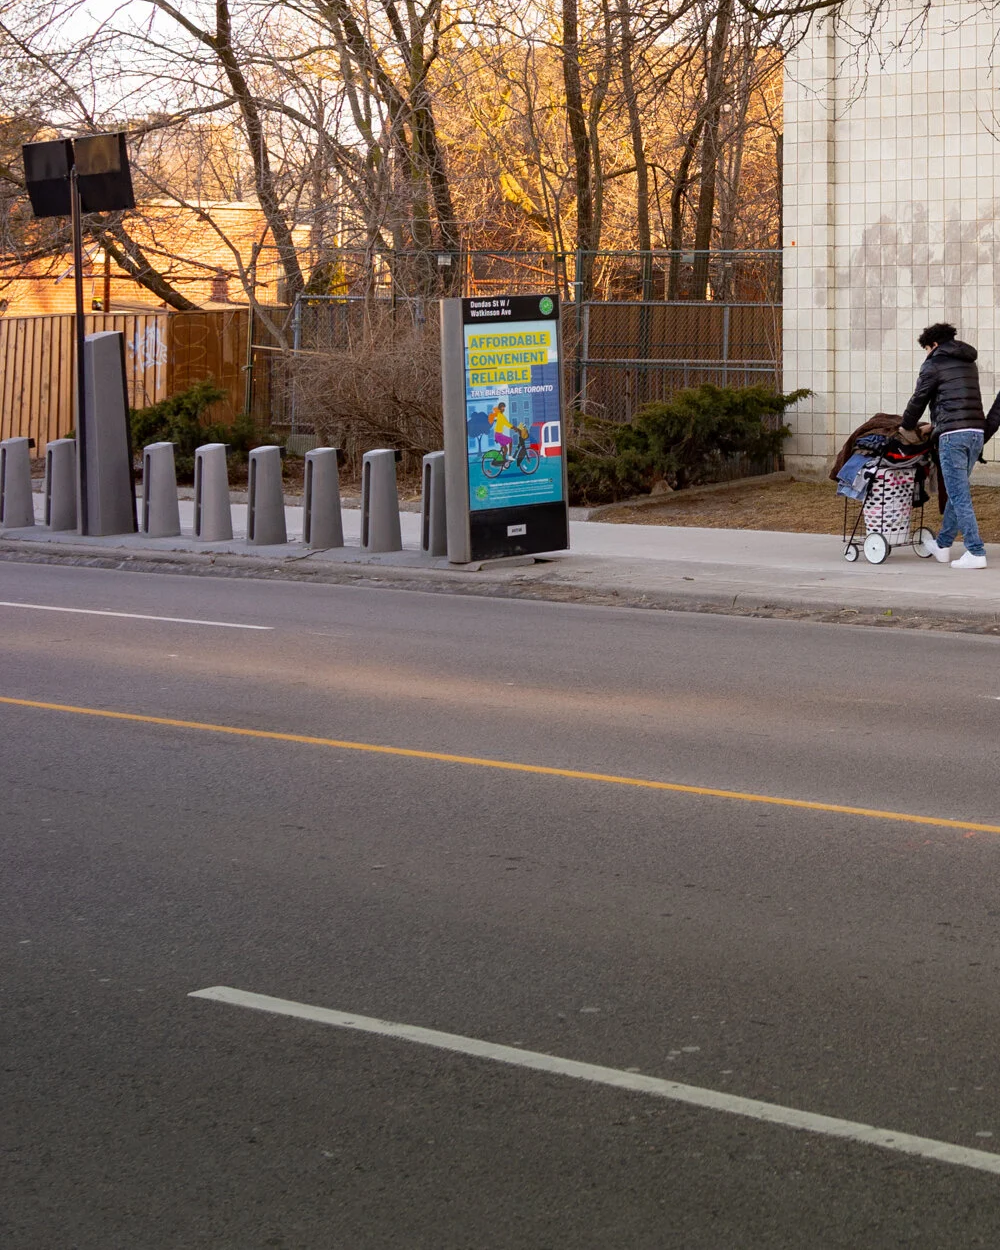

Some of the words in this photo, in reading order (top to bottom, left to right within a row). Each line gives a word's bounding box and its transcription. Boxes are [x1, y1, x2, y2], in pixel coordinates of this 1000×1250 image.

[470, 300, 491, 309] Dundas
[492, 299, 499, 307] St
[500, 299, 506, 307] W
[470, 309, 500, 317] Watkinson
[501, 308, 511, 316] Ave
[470, 333, 546, 348] AFFORDABLE
[471, 351, 544, 366] CONVENIENT
[471, 369, 528, 384] RELIABLE
[471, 390, 483, 398] TRY
[485, 388, 500, 397] BIKE
[500, 386, 522, 396] SHARE
[524, 384, 553, 393] TORONTO
